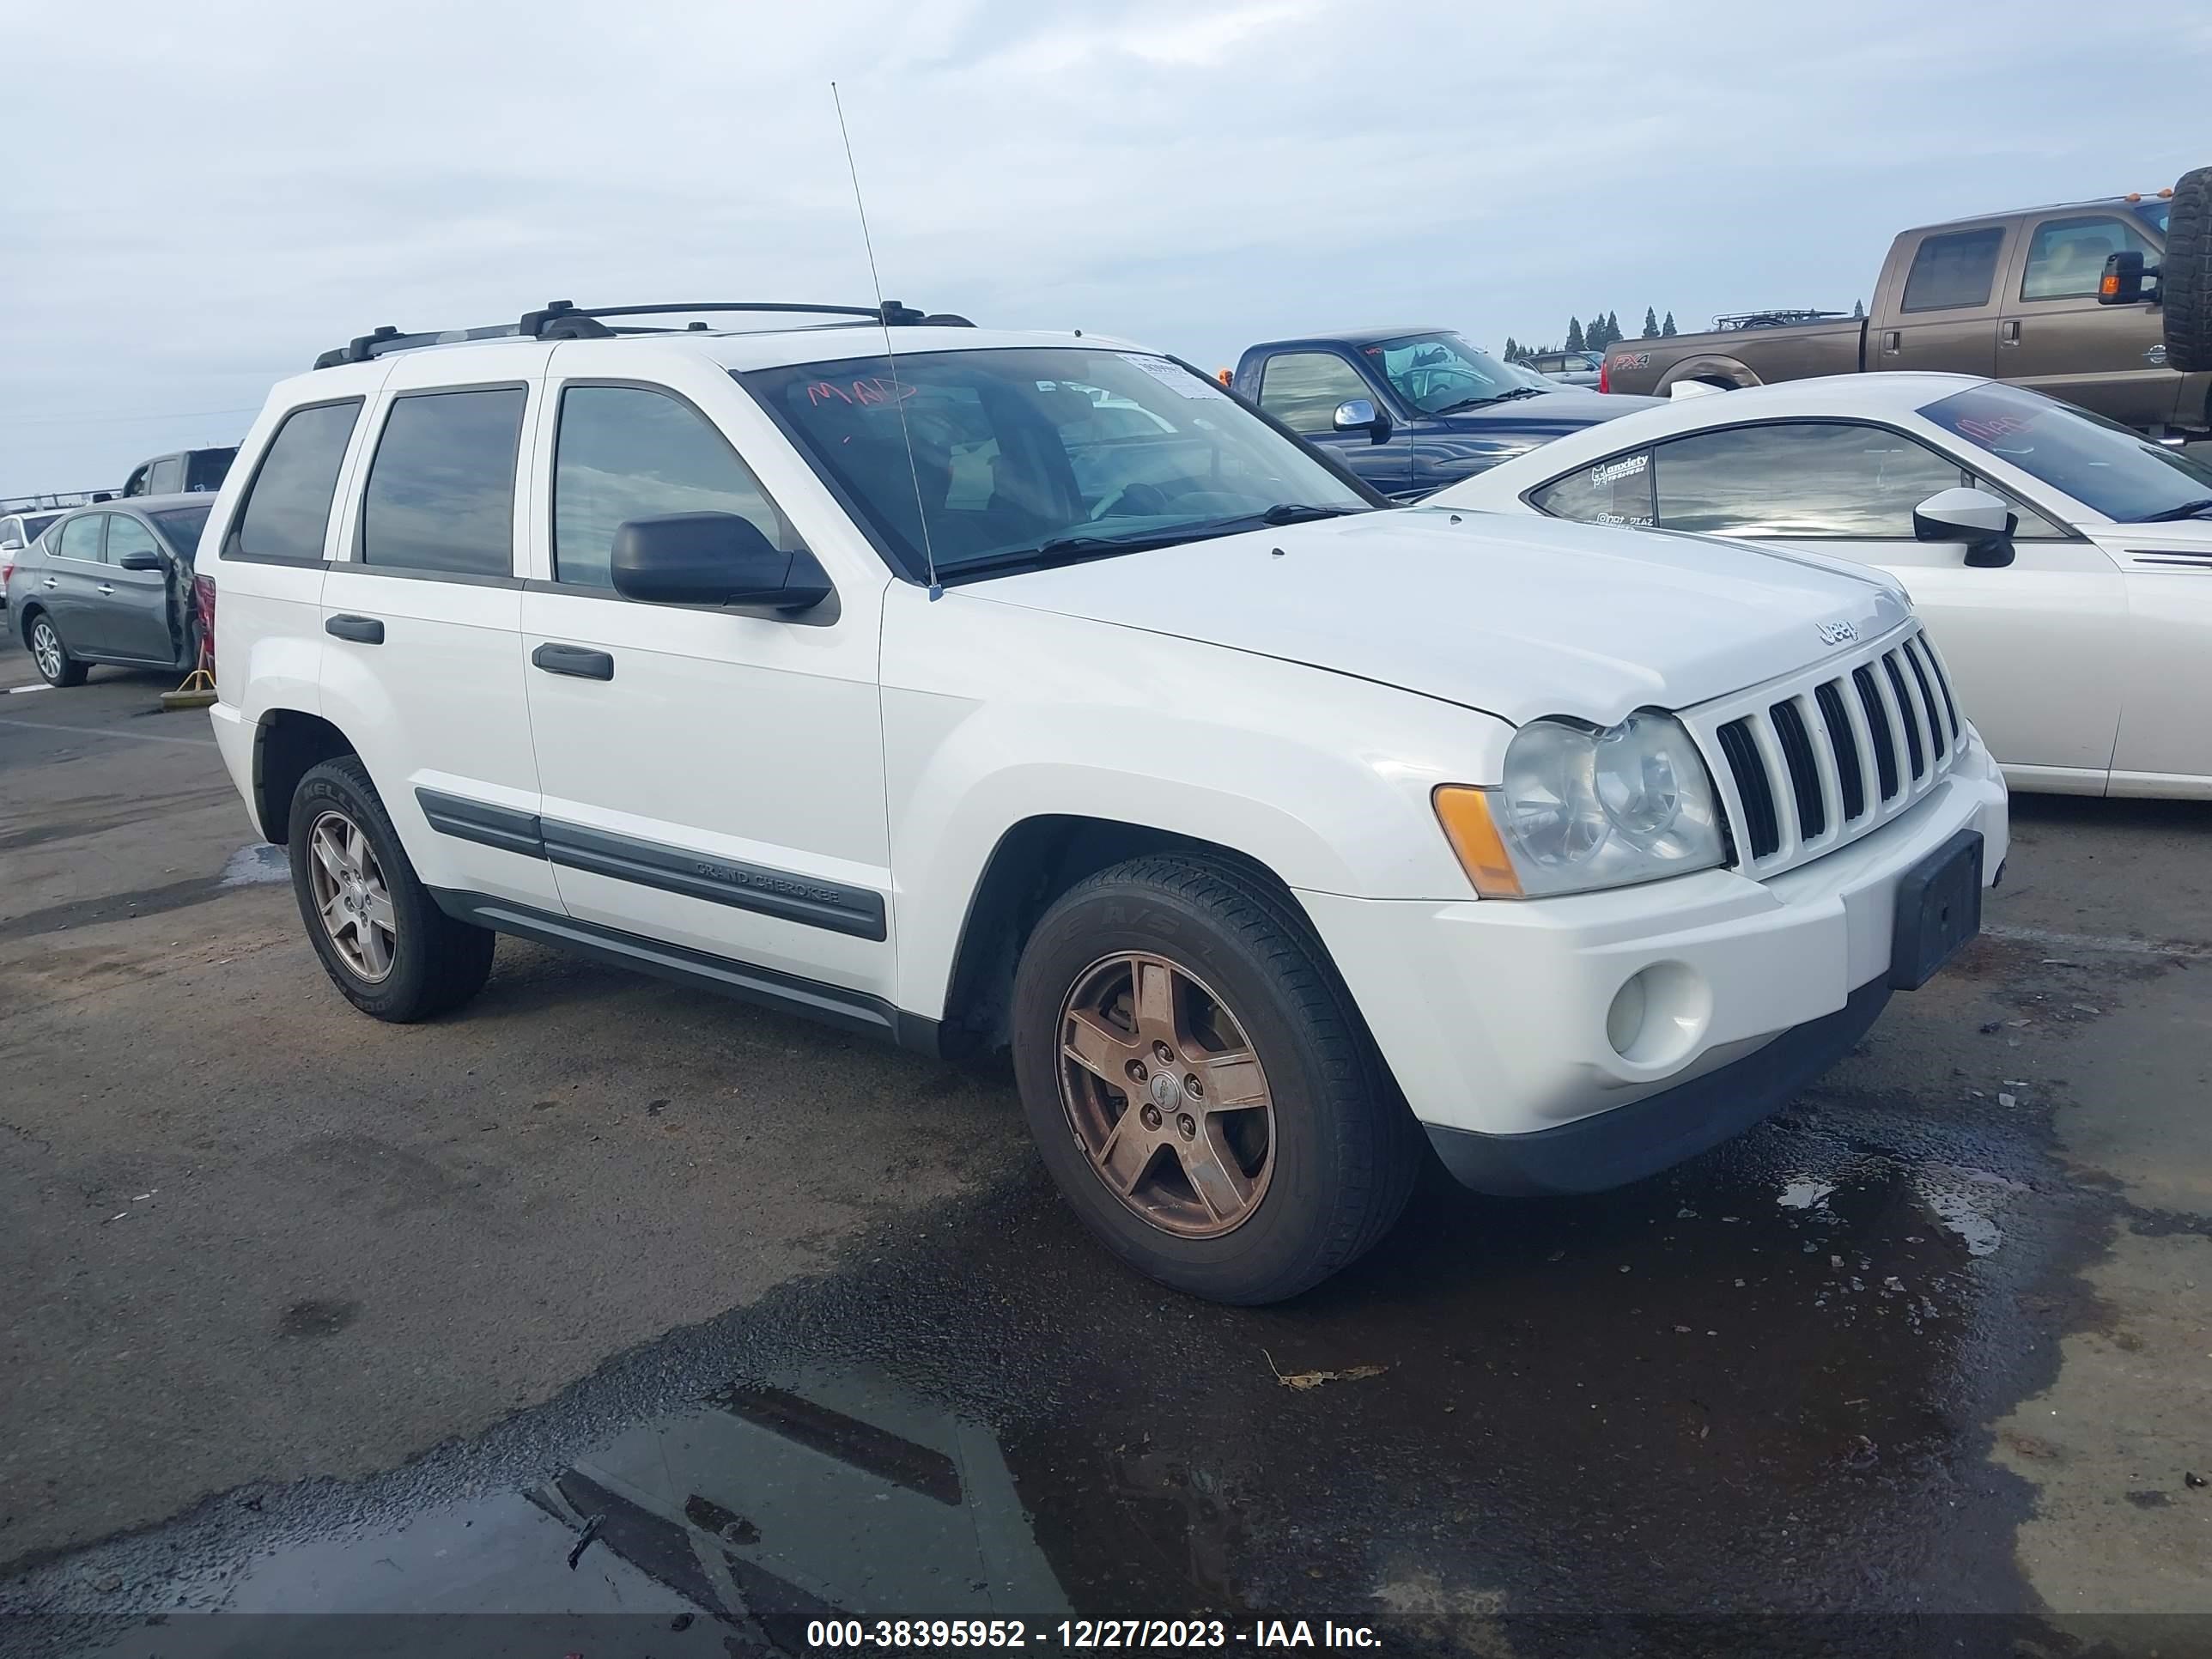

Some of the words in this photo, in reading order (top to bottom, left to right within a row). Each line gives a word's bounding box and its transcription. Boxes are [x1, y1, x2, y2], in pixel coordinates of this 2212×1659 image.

[1613, 352, 1650, 367] FX4
[807, 377, 917, 406] MAD
[1607, 455, 1649, 474] anxiety
[1815, 620, 1859, 646] Jeep
[303, 782, 365, 820] KELLY
[696, 861, 750, 885] GRAND
[756, 874, 842, 904] CHEROKEE
